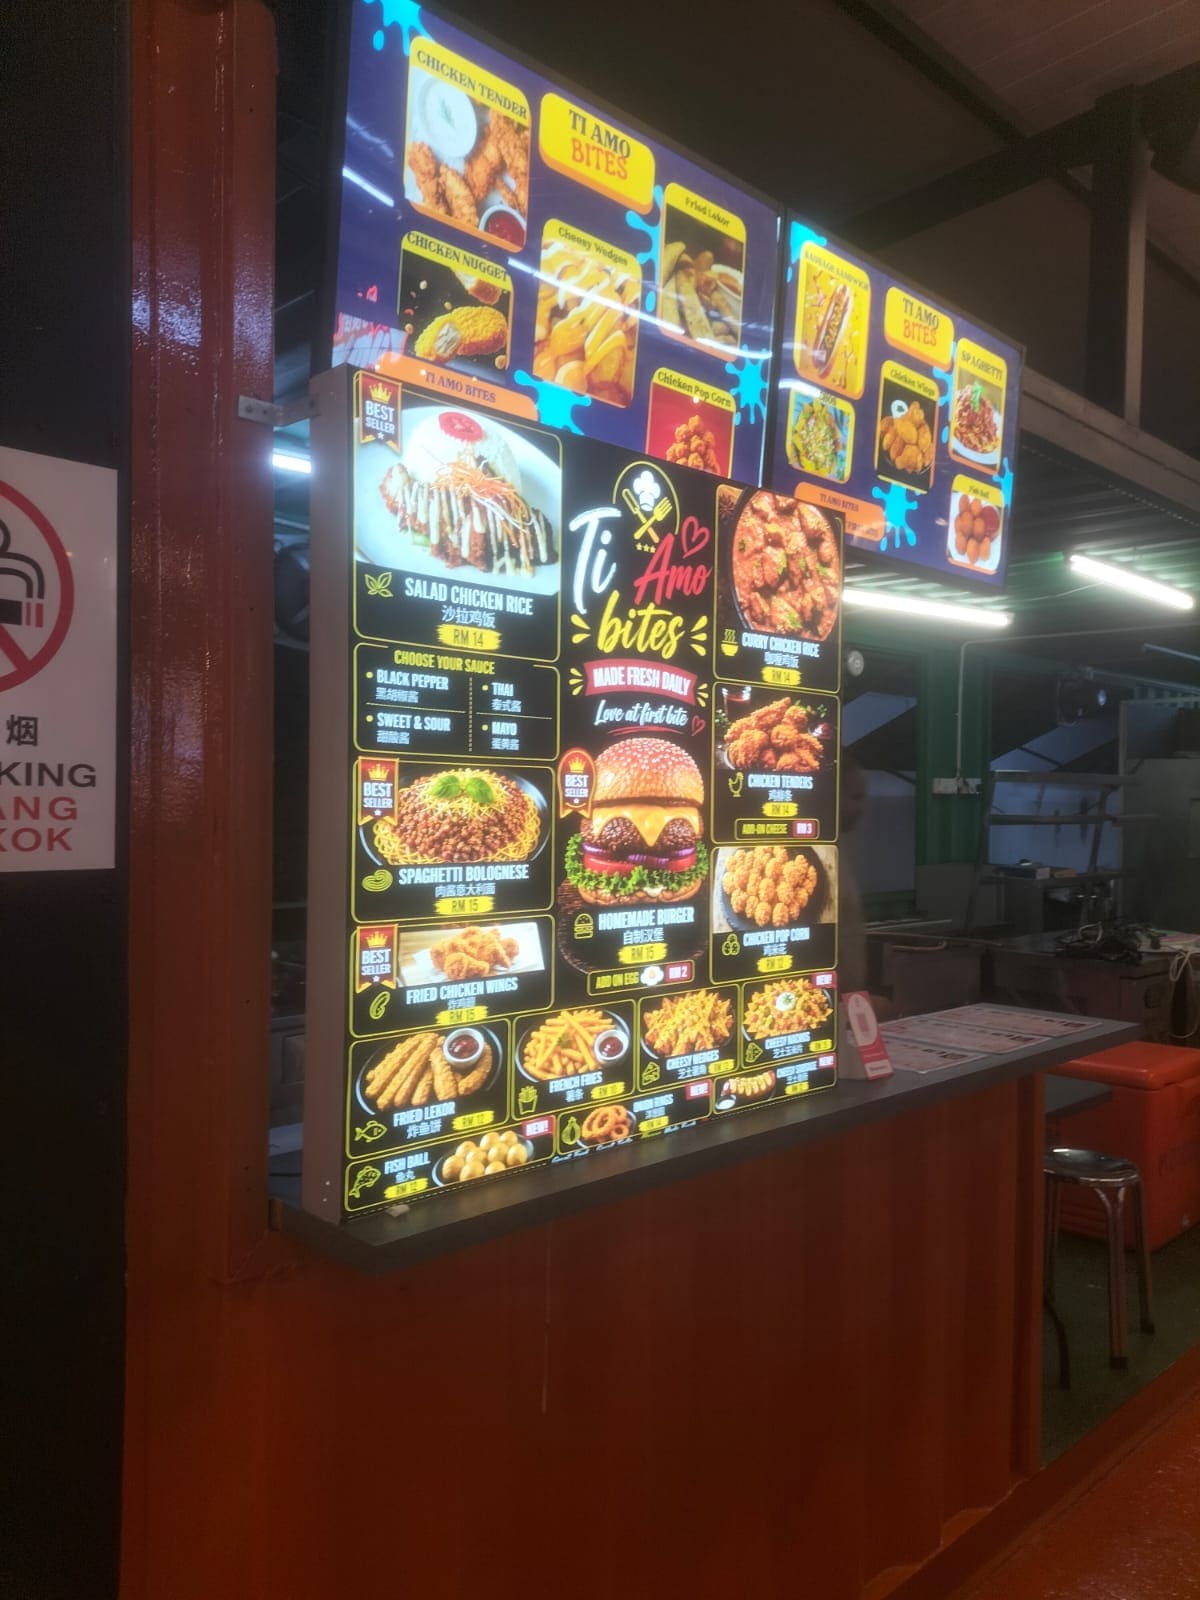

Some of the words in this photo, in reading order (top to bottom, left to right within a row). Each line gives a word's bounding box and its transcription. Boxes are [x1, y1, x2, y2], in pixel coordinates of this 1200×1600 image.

[417, 50, 476, 93] CHICKEN
[479, 83, 527, 119] TENDER
[569, 110, 588, 132] TI
[591, 121, 631, 159] AMO
[572, 140, 629, 181] BITES
[407, 231, 460, 265] CHICKEN
[463, 251, 509, 282] NUGGET
[902, 298, 914, 314] TI
[915, 303, 940, 328] AMO
[903, 322, 937, 347] BITES
[961, 350, 1003, 381] SPAGHETTI
[424, 371, 438, 386] TI
[438, 377, 464, 394] AMO
[466, 385, 497, 404] BITES
[657, 370, 693, 394] Chicken
[695, 382, 714, 402] Pop
[715, 389, 732, 408] Corn
[366, 400, 395, 421] BEST
[365, 416, 395, 434] SELLER
[568, 507, 622, 615] Ti
[633, 532, 713, 606] Amo
[404, 576, 448, 602] SALAD
[450, 586, 503, 611] CHICKEN
[505, 595, 534, 616] RICE
[441, 605, 496, 629] 沙拉鸡饭
[597, 590, 685, 659] bites
[453, 629, 470, 646] RM
[473, 631, 484, 647] 14
[394, 650, 435, 669] CHOOSE
[436, 655, 464, 672] YOUR
[464, 659, 496, 675] SAUCE
[376, 669, 409, 687] BLACK
[411, 674, 449, 690] PEPPER
[491, 681, 514, 697] THAI
[592, 666, 625, 689] MADE
[627, 666, 661, 688] FRESH
[661, 671, 691, 697] DAILY
[376, 712, 412, 729] SWEET
[413, 715, 422, 730] &
[423, 717, 451, 732] SOUR
[594, 699, 624, 726] Love
[625, 705, 642, 722] at
[639, 704, 666, 728] first
[665, 707, 689, 727] bite
[6, 714, 38, 746] 烟
[491, 721, 518, 736] MAYO
[363, 781, 393, 797] BEST
[564, 774, 589, 787] BEST
[0, 796, 78, 821] NG
[399, 866, 465, 885] SPAGHETTI
[466, 863, 530, 882] BOLOGNESE
[451, 900, 465, 912] RM
[469, 899, 479, 911] 15
[598, 909, 656, 930] HOMEMADE
[657, 906, 695, 924] BURGER
[361, 949, 391, 964] BEST
[361, 964, 391, 976] SELLER
[406, 987, 438, 1005] FRIED
[439, 981, 484, 1000] CHICKEN
[393, 1107, 424, 1127] FRIED
